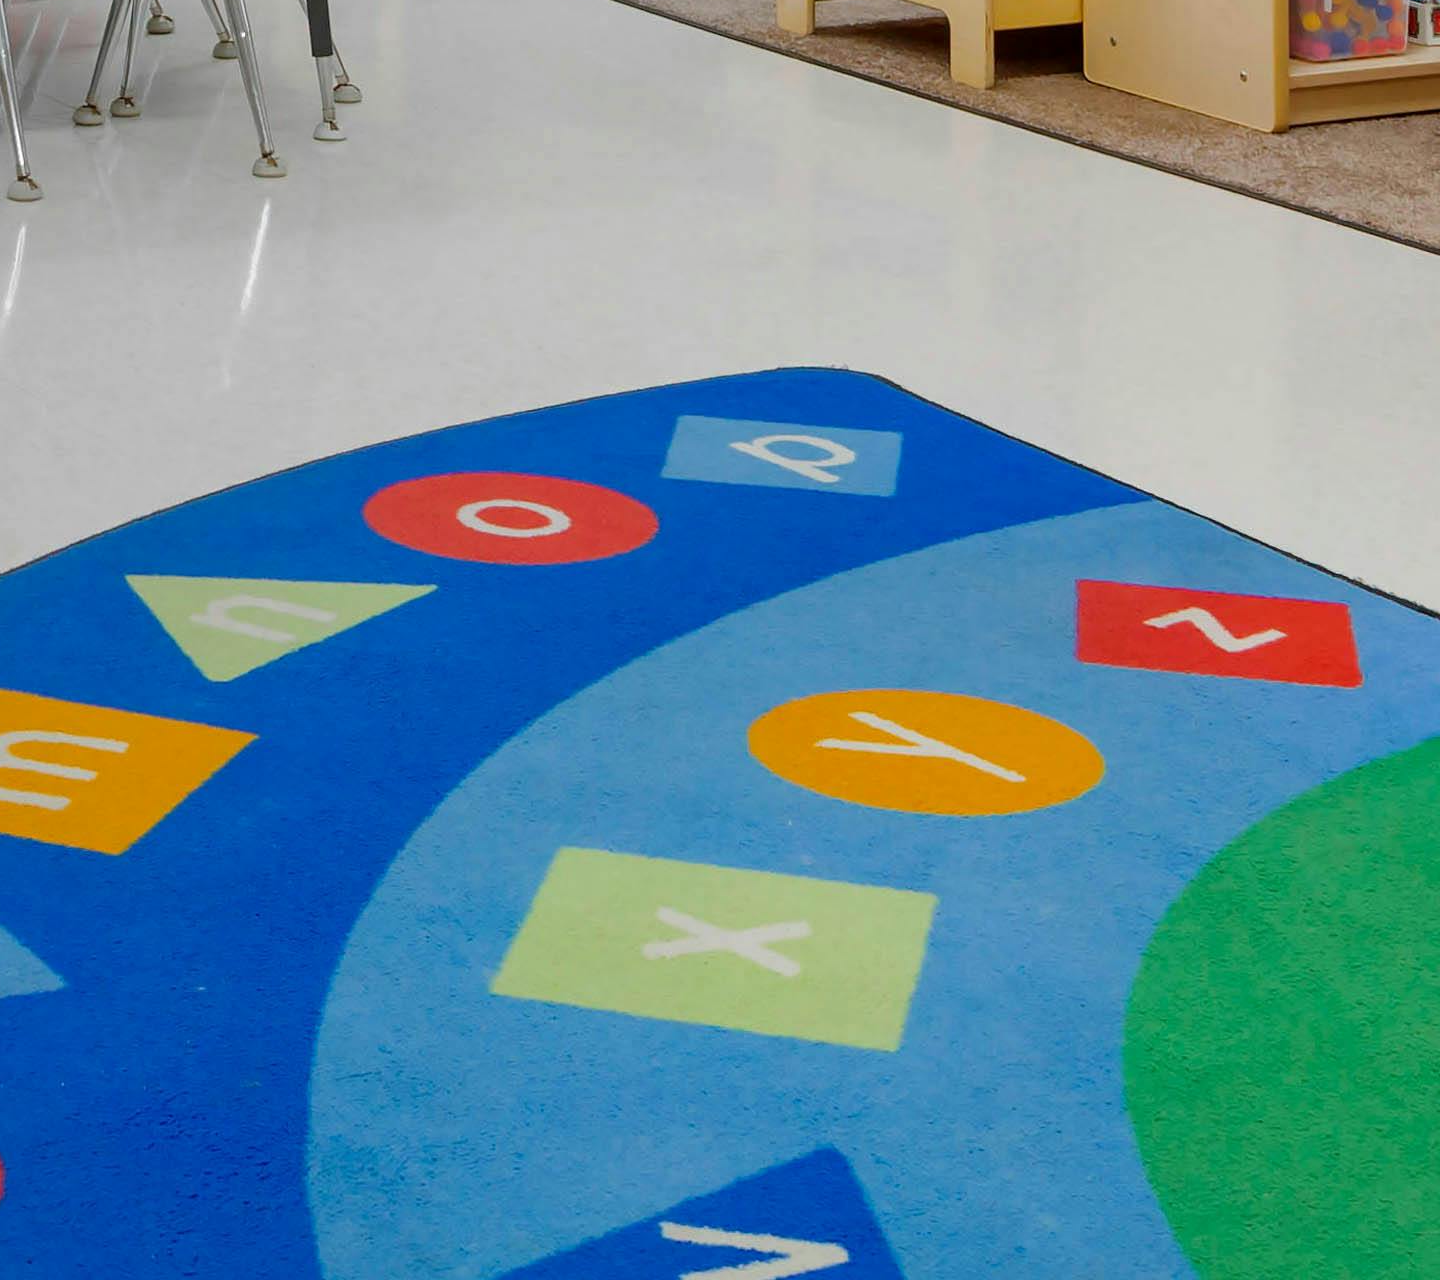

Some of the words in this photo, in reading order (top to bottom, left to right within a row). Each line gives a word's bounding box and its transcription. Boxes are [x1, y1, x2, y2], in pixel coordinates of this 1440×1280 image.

[456, 498, 572, 537] o
[188, 592, 338, 642] n
[814, 711, 1026, 783] y
[642, 906, 812, 978] x
